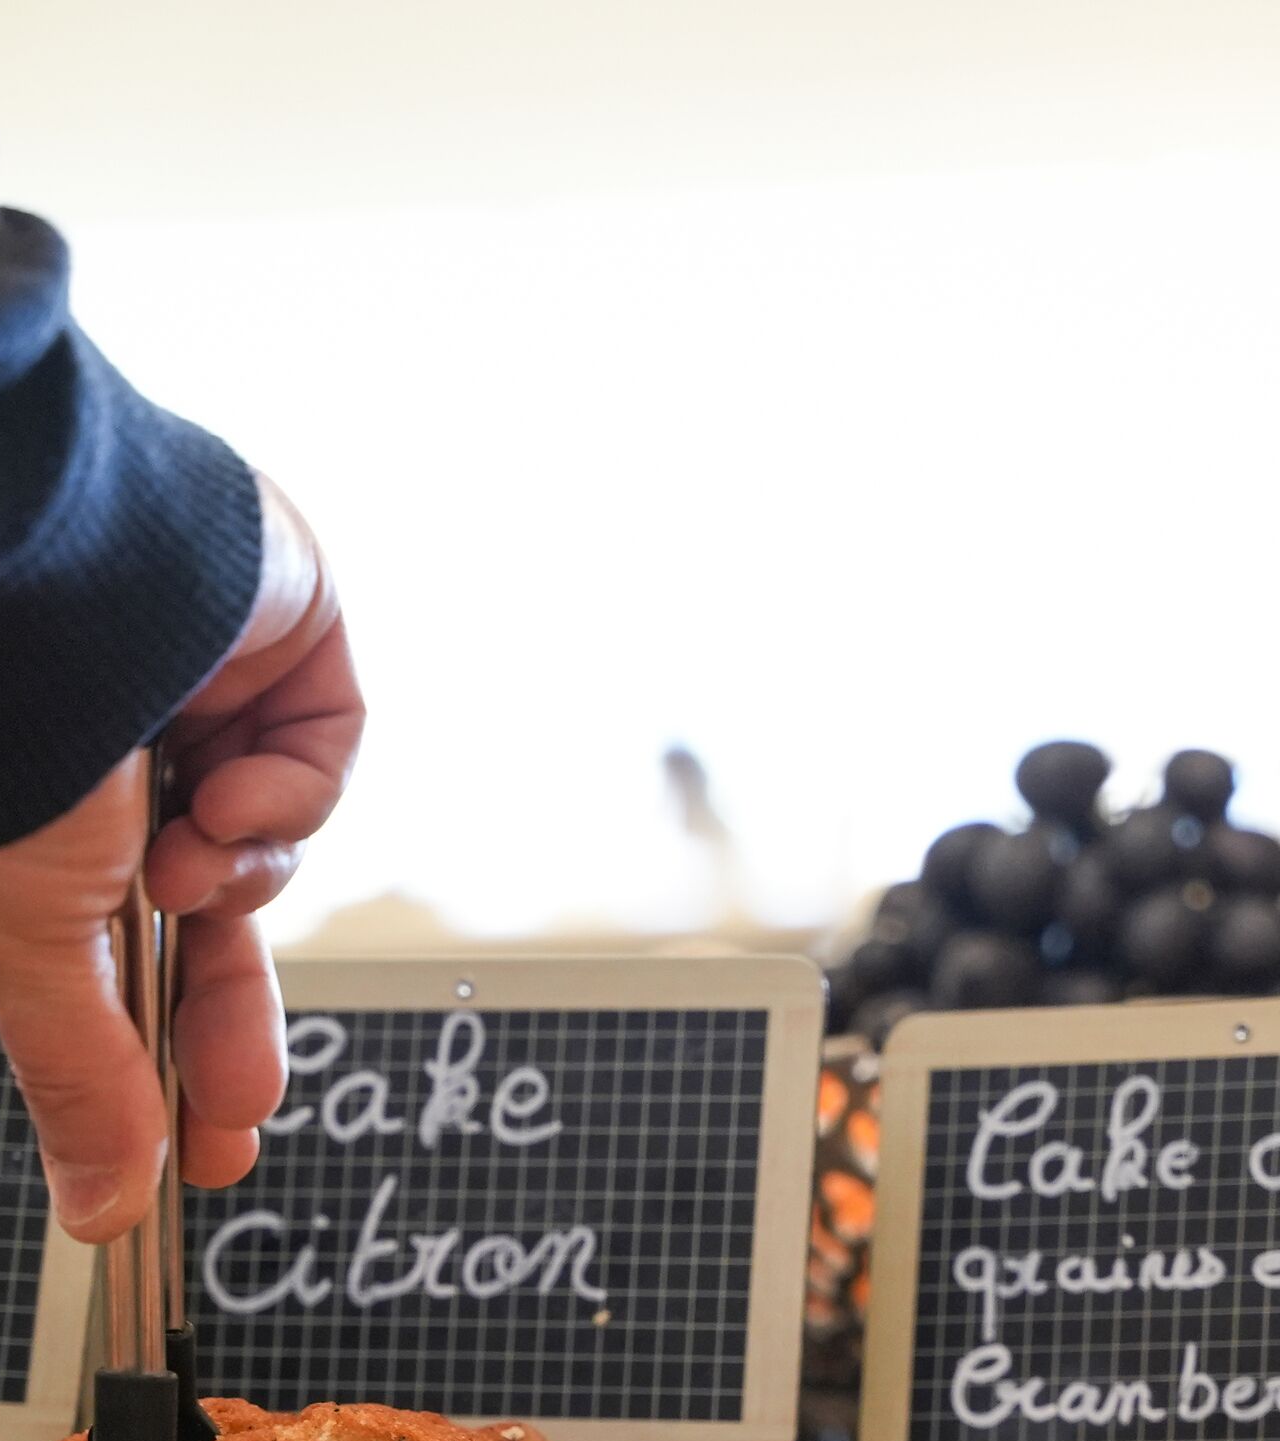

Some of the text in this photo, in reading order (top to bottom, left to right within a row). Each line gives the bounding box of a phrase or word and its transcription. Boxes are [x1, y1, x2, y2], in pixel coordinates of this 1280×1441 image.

[264, 1010, 564, 1150] Cake
[966, 1075, 1200, 1203] Cake
[203, 1174, 608, 1314] Citron
